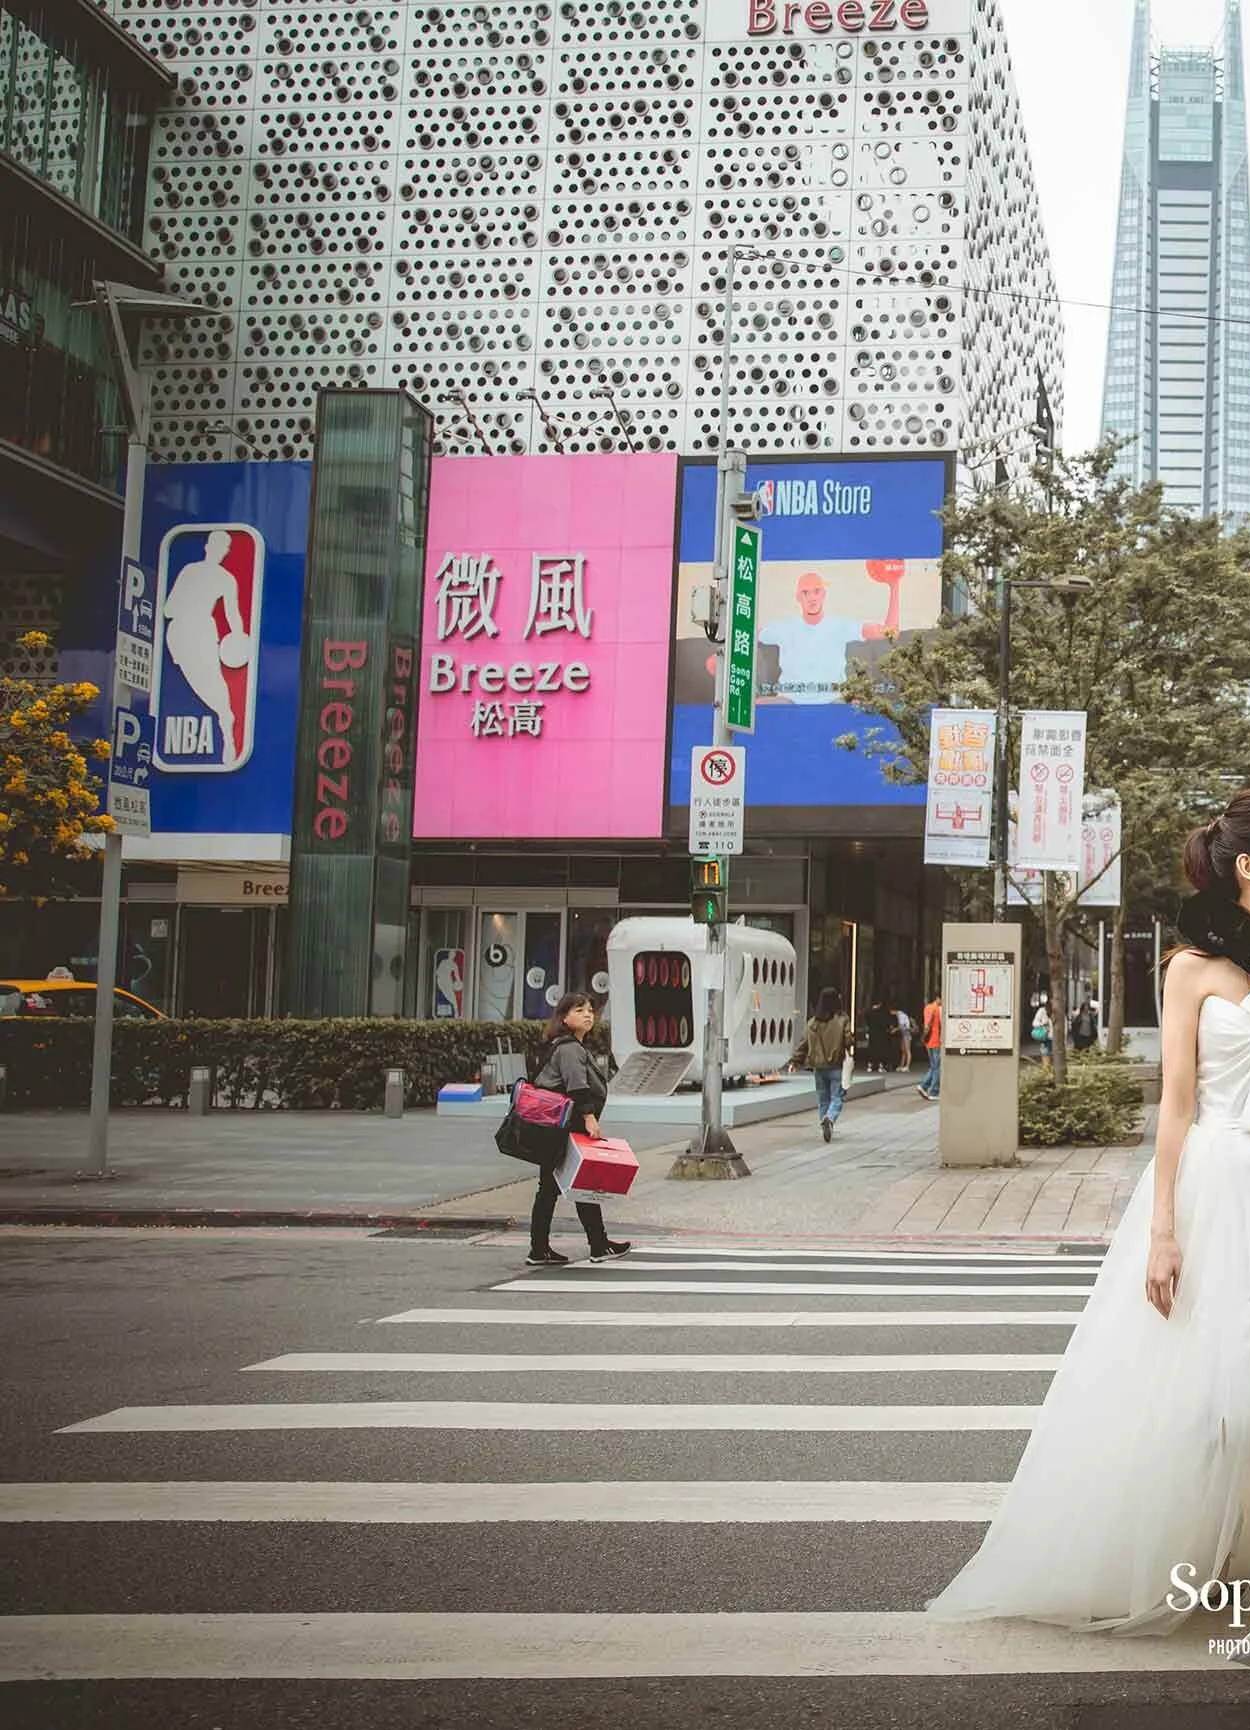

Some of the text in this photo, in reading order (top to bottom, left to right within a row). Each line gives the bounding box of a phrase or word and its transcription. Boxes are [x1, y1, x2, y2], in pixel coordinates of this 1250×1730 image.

[748, 0, 928, 36] Breeze
[776, 479, 871, 515] NBA Store
[124, 563, 145, 611] P
[435, 551, 593, 641] 微風
[734, 555, 753, 656] 松高路
[429, 654, 592, 694] Breeze
[730, 663, 750, 680] Song
[730, 674, 745, 687] Gao
[116, 711, 141, 758] P
[164, 715, 214, 755] NBA
[470, 699, 547, 738] 松高
[314, 639, 368, 841] Breeze
[715, 841, 734, 850] 110
[243, 880, 289, 896] Bree
[704, 862, 719, 885] 17
